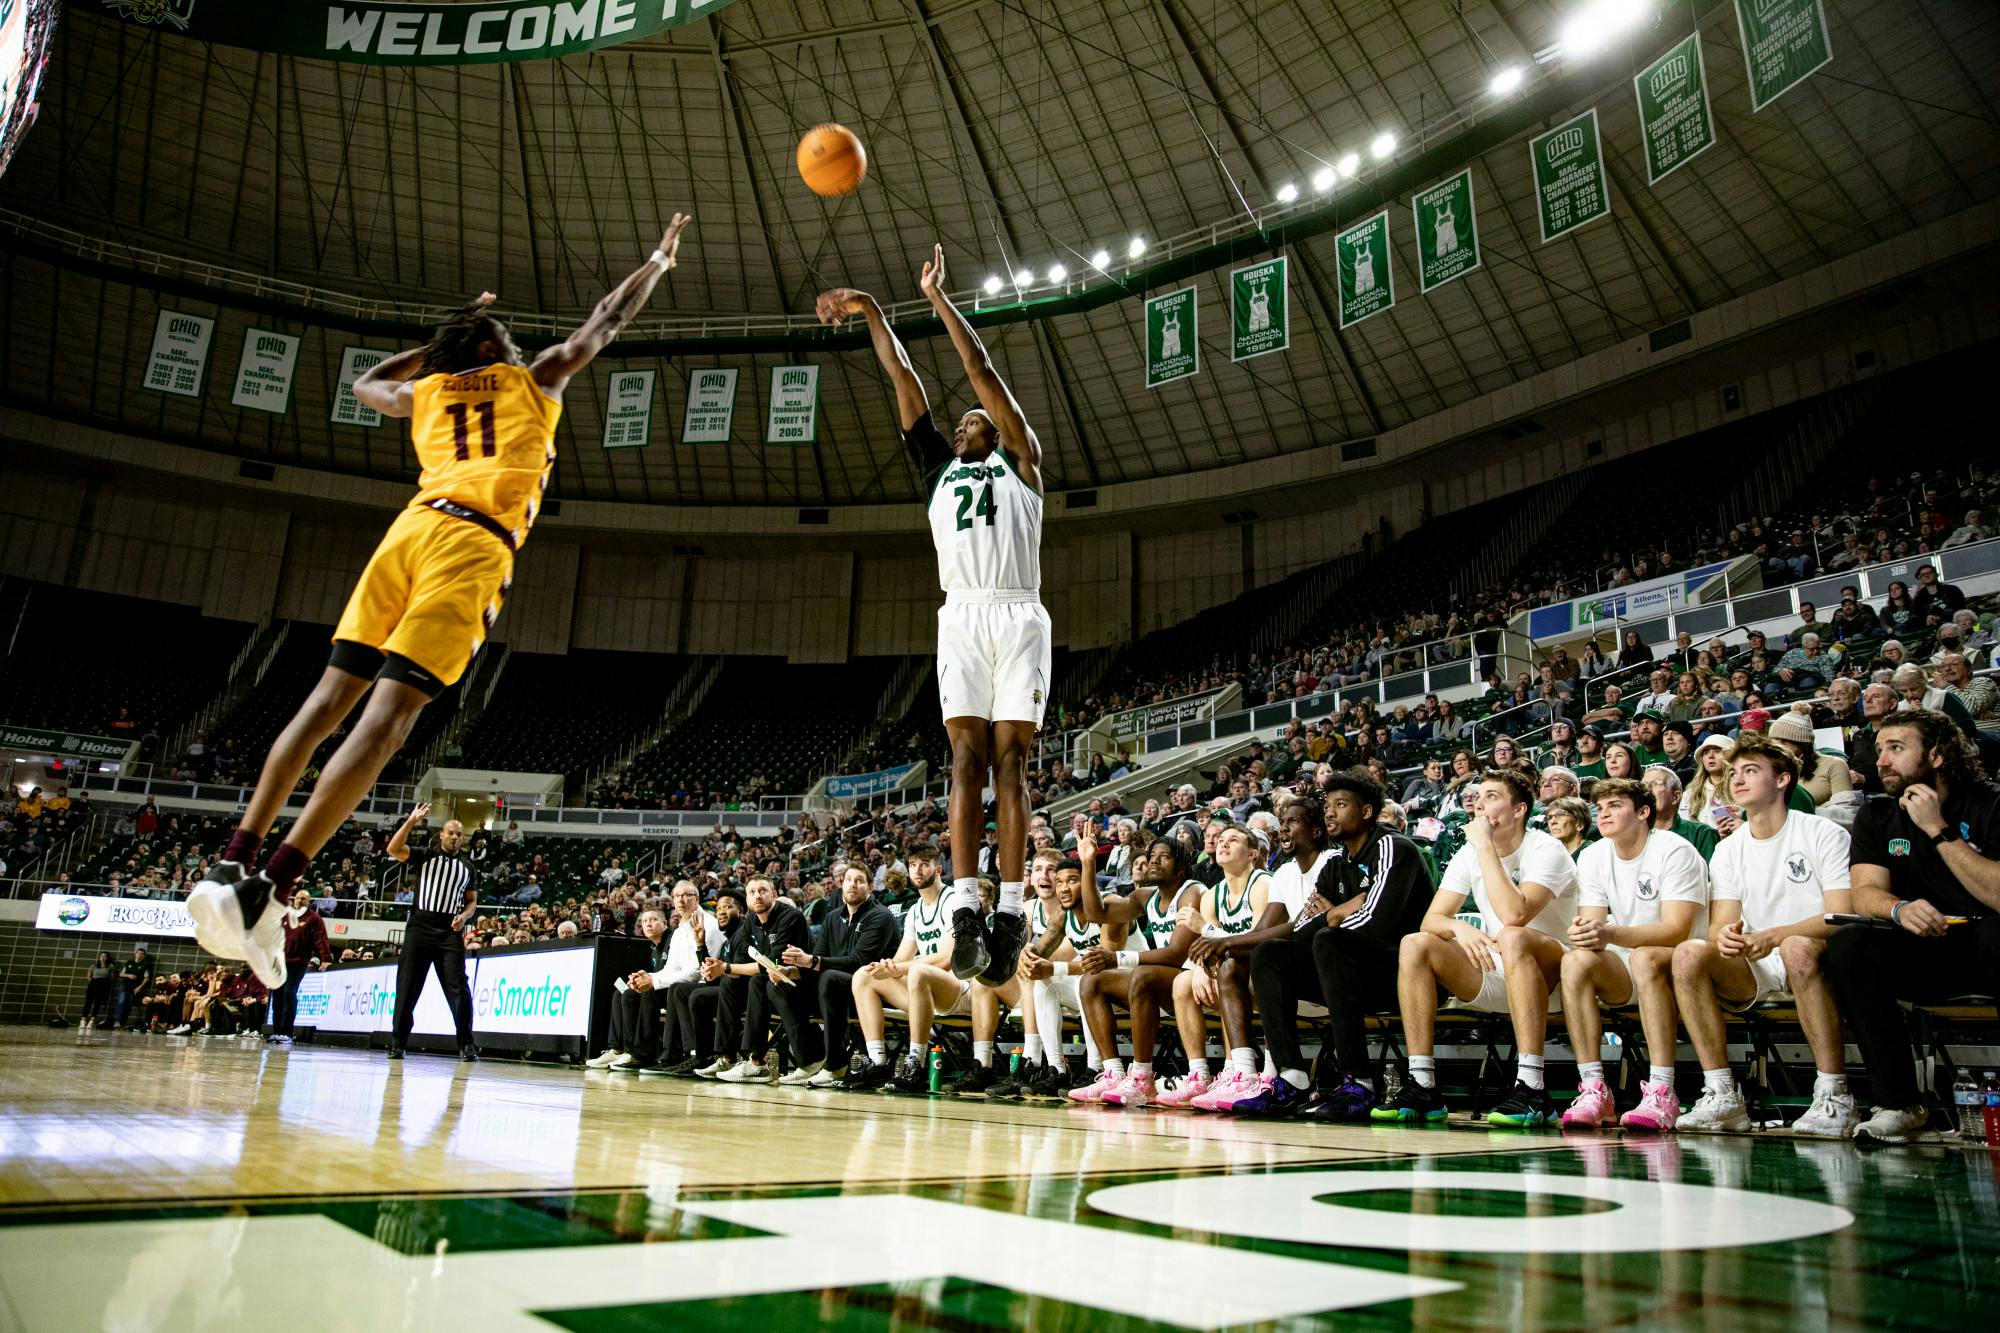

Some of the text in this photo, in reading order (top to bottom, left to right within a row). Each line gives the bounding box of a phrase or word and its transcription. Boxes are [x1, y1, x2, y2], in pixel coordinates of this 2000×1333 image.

[327, 0, 638, 56] WELCOME
[1752, 4, 1813, 56] TOURNAMENT
[1770, 11, 1792, 33] MAC
[1757, 17, 1812, 63] CHAMPIONS
[1760, 30, 1813, 74] 1995 1997
[1652, 57, 1686, 96] OHIO
[1762, 62, 1785, 85] 2001
[1648, 90, 1701, 132] TOURNAMENT
[1664, 93, 1682, 113] MAC
[1652, 103, 1700, 139] CHAMPIONS
[1655, 113, 1701, 150] 1973 1974
[1547, 128, 1583, 162] OHIO
[1656, 123, 1702, 160] 1975 1976
[1551, 149, 1582, 169] WRESTLING
[1657, 133, 1704, 170] 1993 1994
[1542, 162, 1597, 194] TOURNAMENT
[1558, 162, 1578, 178] MAC
[1423, 179, 1461, 206] GARDNER
[1546, 172, 1595, 202] CHAMPIONS
[1549, 184, 1596, 212] 1955 1956
[1550, 192, 1598, 221] 1957 1970
[1551, 202, 1599, 230] 1971 1972
[1346, 222, 1378, 245] DANIELS
[1426, 251, 1473, 277] CHAMPION
[1427, 246, 1470, 270] NATIONAL
[1243, 265, 1275, 282] HOUSKA
[1436, 262, 1464, 280] 1998
[1155, 294, 1187, 311] BLOSSER
[1345, 291, 1387, 315] CHAMPION
[1347, 286, 1386, 308] NATIONAL
[169, 319, 201, 338] OHIO
[1238, 327, 1280, 342] NATIONAL
[256, 337, 287, 355] OHIO
[1236, 332, 1283, 348] CHAMPION
[1246, 342, 1273, 353] 1964
[156, 352, 199, 366] CHAMPIONS
[170, 348, 188, 358] MAC
[1152, 354, 1191, 369] NATIONAL
[258, 366, 275, 374] MAC
[1151, 358, 1193, 375] CHAMPION
[1159, 367, 1185, 379] 1932
[150, 378, 170, 387] 2007
[244, 369, 286, 383] CHAMPIONS
[619, 377, 644, 391] OHIO
[700, 374, 726, 388] OHIO
[782, 371, 808, 386] OHIO
[241, 387, 260, 396] 2014
[242, 380, 283, 394] 2012 2013
[608, 410, 648, 419] TOURNAMENT
[774, 416, 799, 425] SWEET
[445, 401, 496, 461] 11
[778, 427, 804, 437] 2005
[954, 483, 998, 531] 24
[1633, 592, 1664, 605] Athens,
[1112, 720, 1133, 729] FIGHT
[1120, 712, 1134, 721] FLY
[1149, 707, 1196, 725] AIR FORCE
[4, 732, 55, 747] Holzer
[1118, 726, 1132, 735] WIN
[80, 741, 128, 755] Holzer
[107, 904, 198, 930] FROGRAN
[343, 983, 397, 1016] TicketSma
